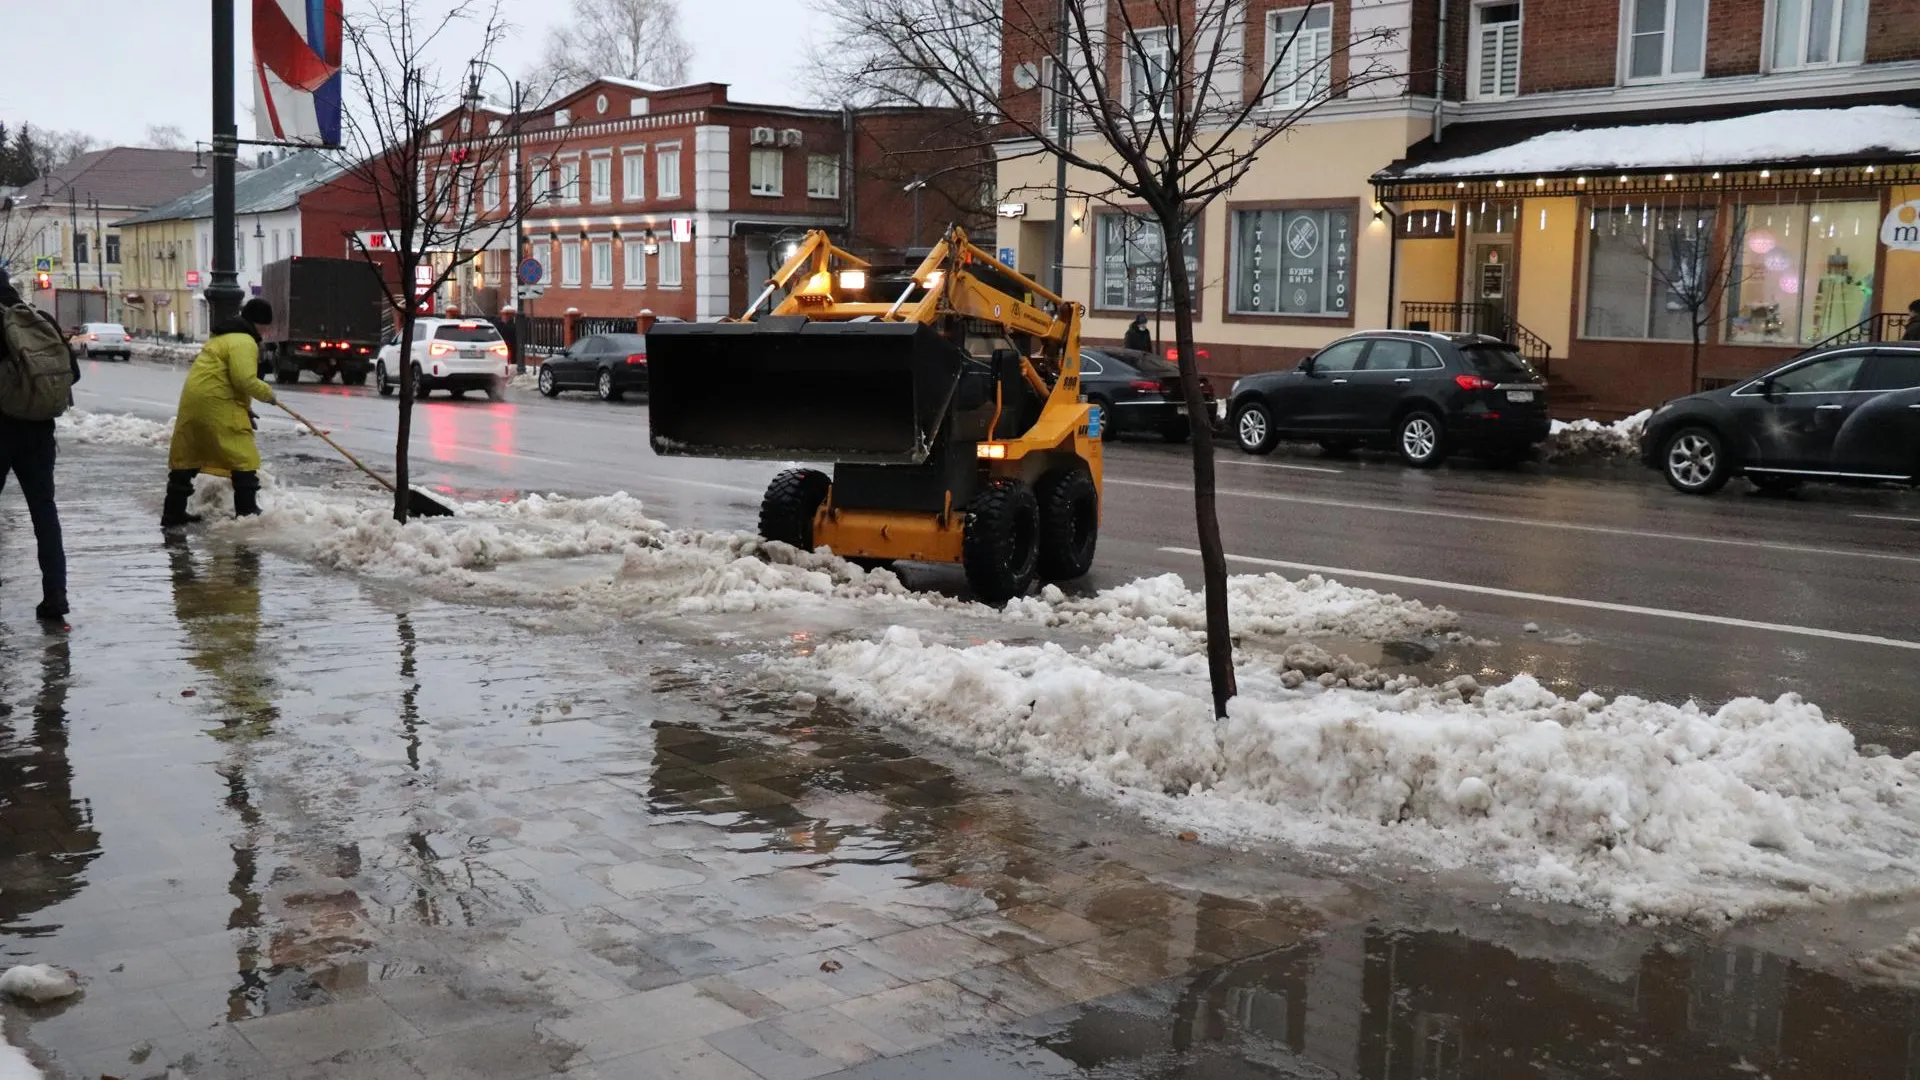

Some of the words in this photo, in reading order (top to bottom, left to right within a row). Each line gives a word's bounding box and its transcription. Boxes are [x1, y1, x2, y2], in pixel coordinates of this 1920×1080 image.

[1252, 231, 1262, 306] TATTOO
[1289, 268, 1314, 276] БУДЕМ
[1336, 229, 1346, 307] TATTOO
